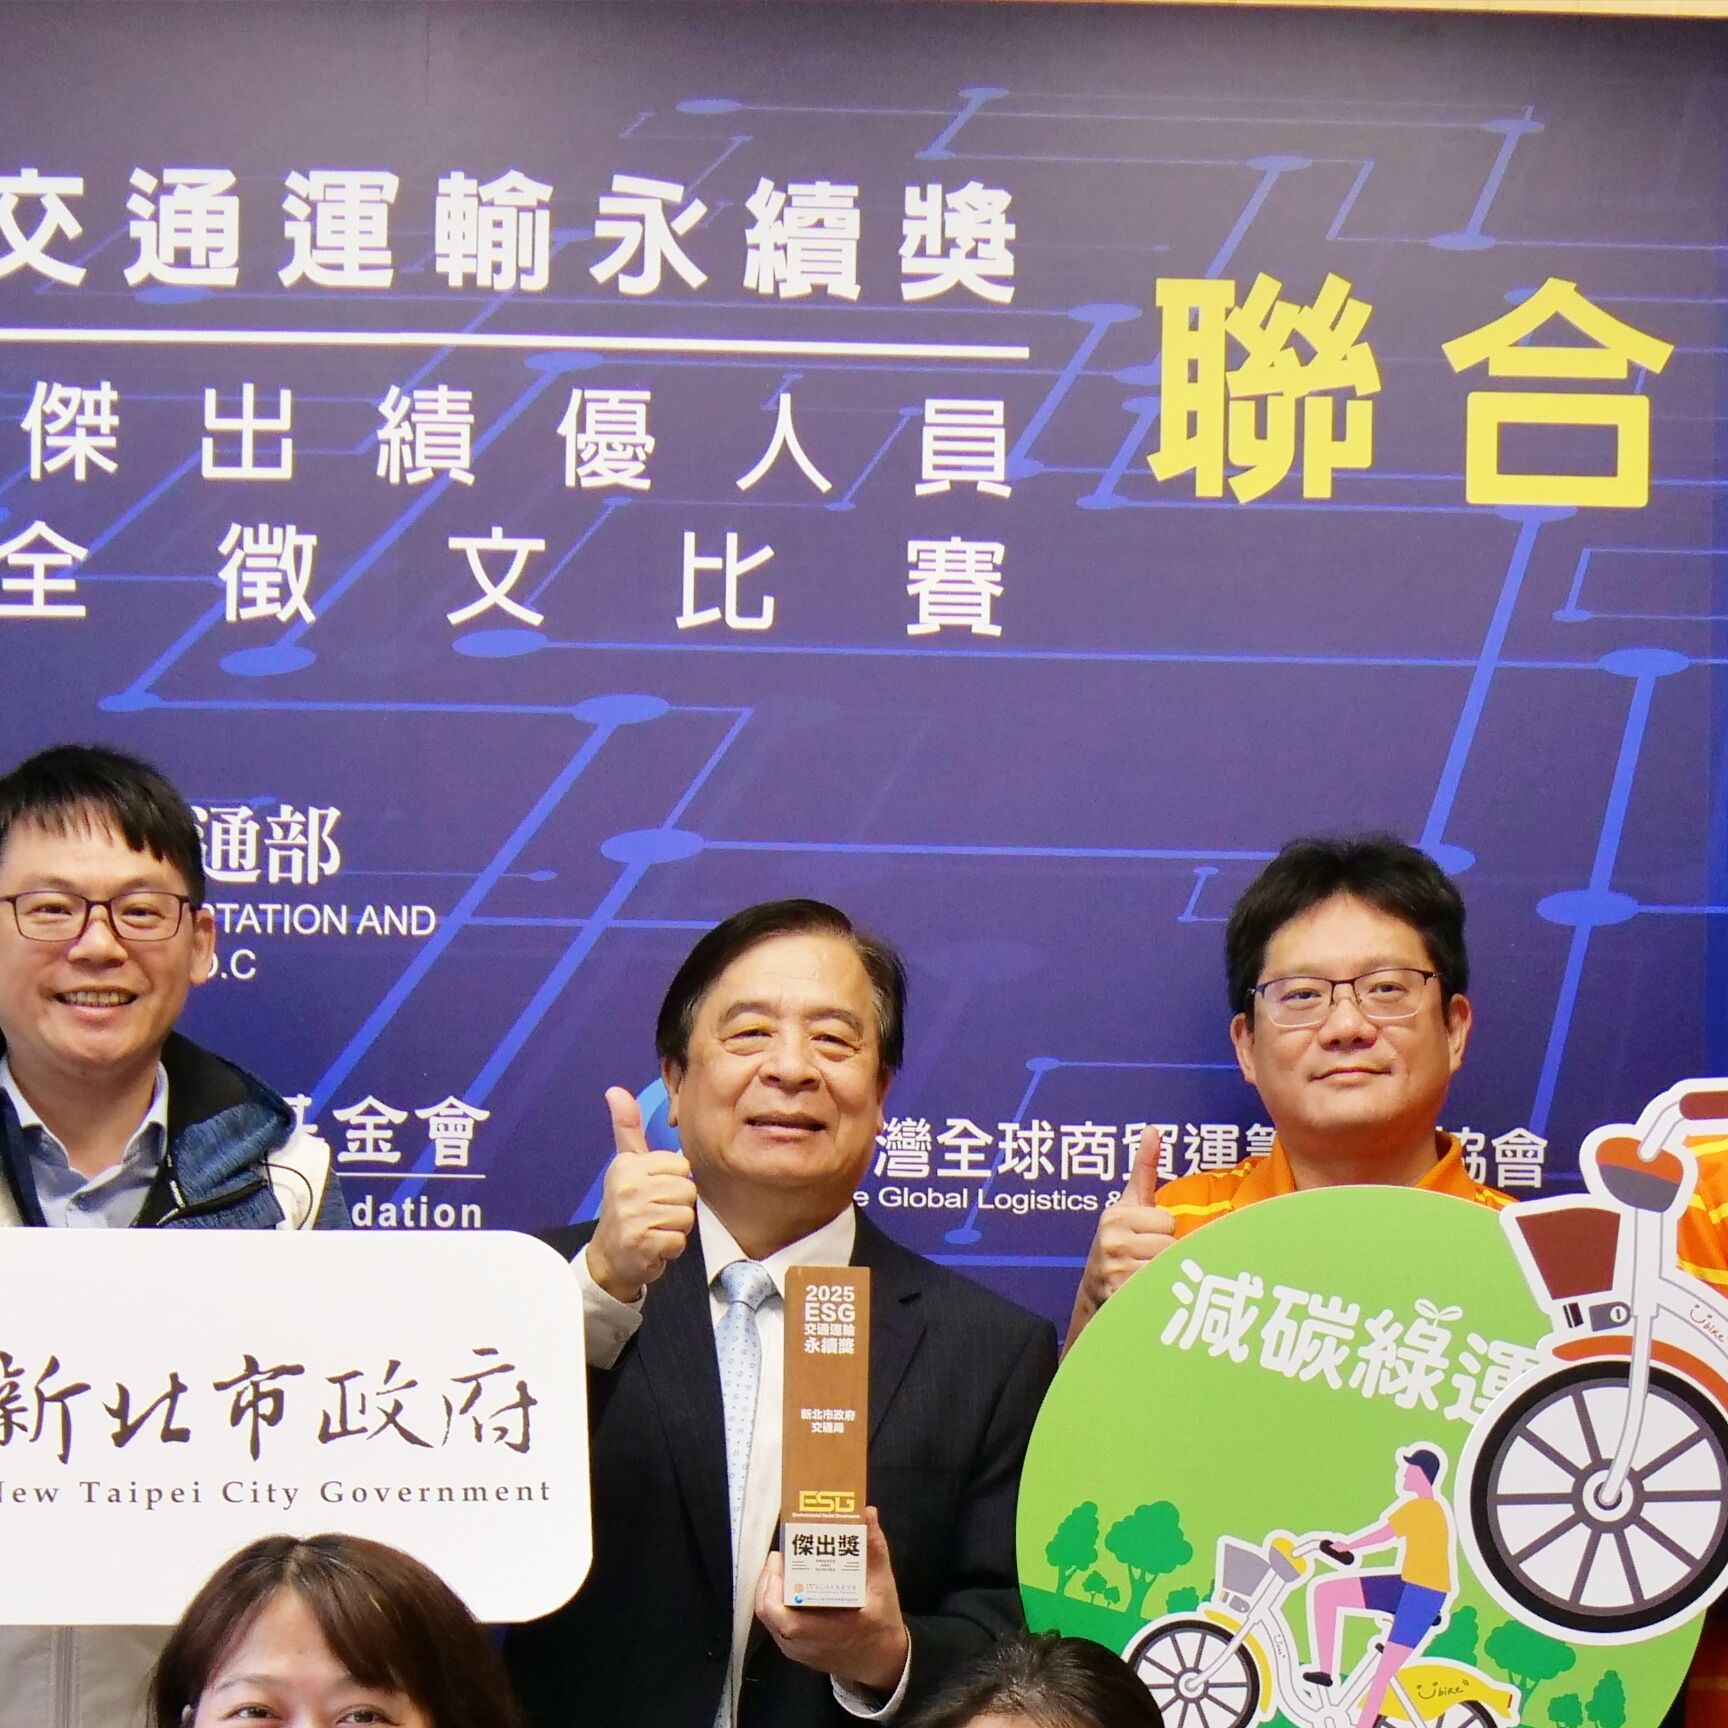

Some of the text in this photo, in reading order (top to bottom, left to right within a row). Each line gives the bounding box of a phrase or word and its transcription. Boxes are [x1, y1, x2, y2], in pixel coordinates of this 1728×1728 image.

[356, 905, 436, 937] AND
[878, 1186, 969, 1210] Global
[977, 1188, 1099, 1216] Logistics
[805, 1285, 856, 1302] 2025
[804, 1302, 856, 1322] ESG
[800, 1408, 856, 1421] 新北市政府
[79, 1480, 202, 1511] Taipei
[221, 1480, 300, 1511] City
[319, 1478, 552, 1504] Government
[799, 1490, 855, 1513] ESG
[792, 1533, 861, 1557] 傑出獎
